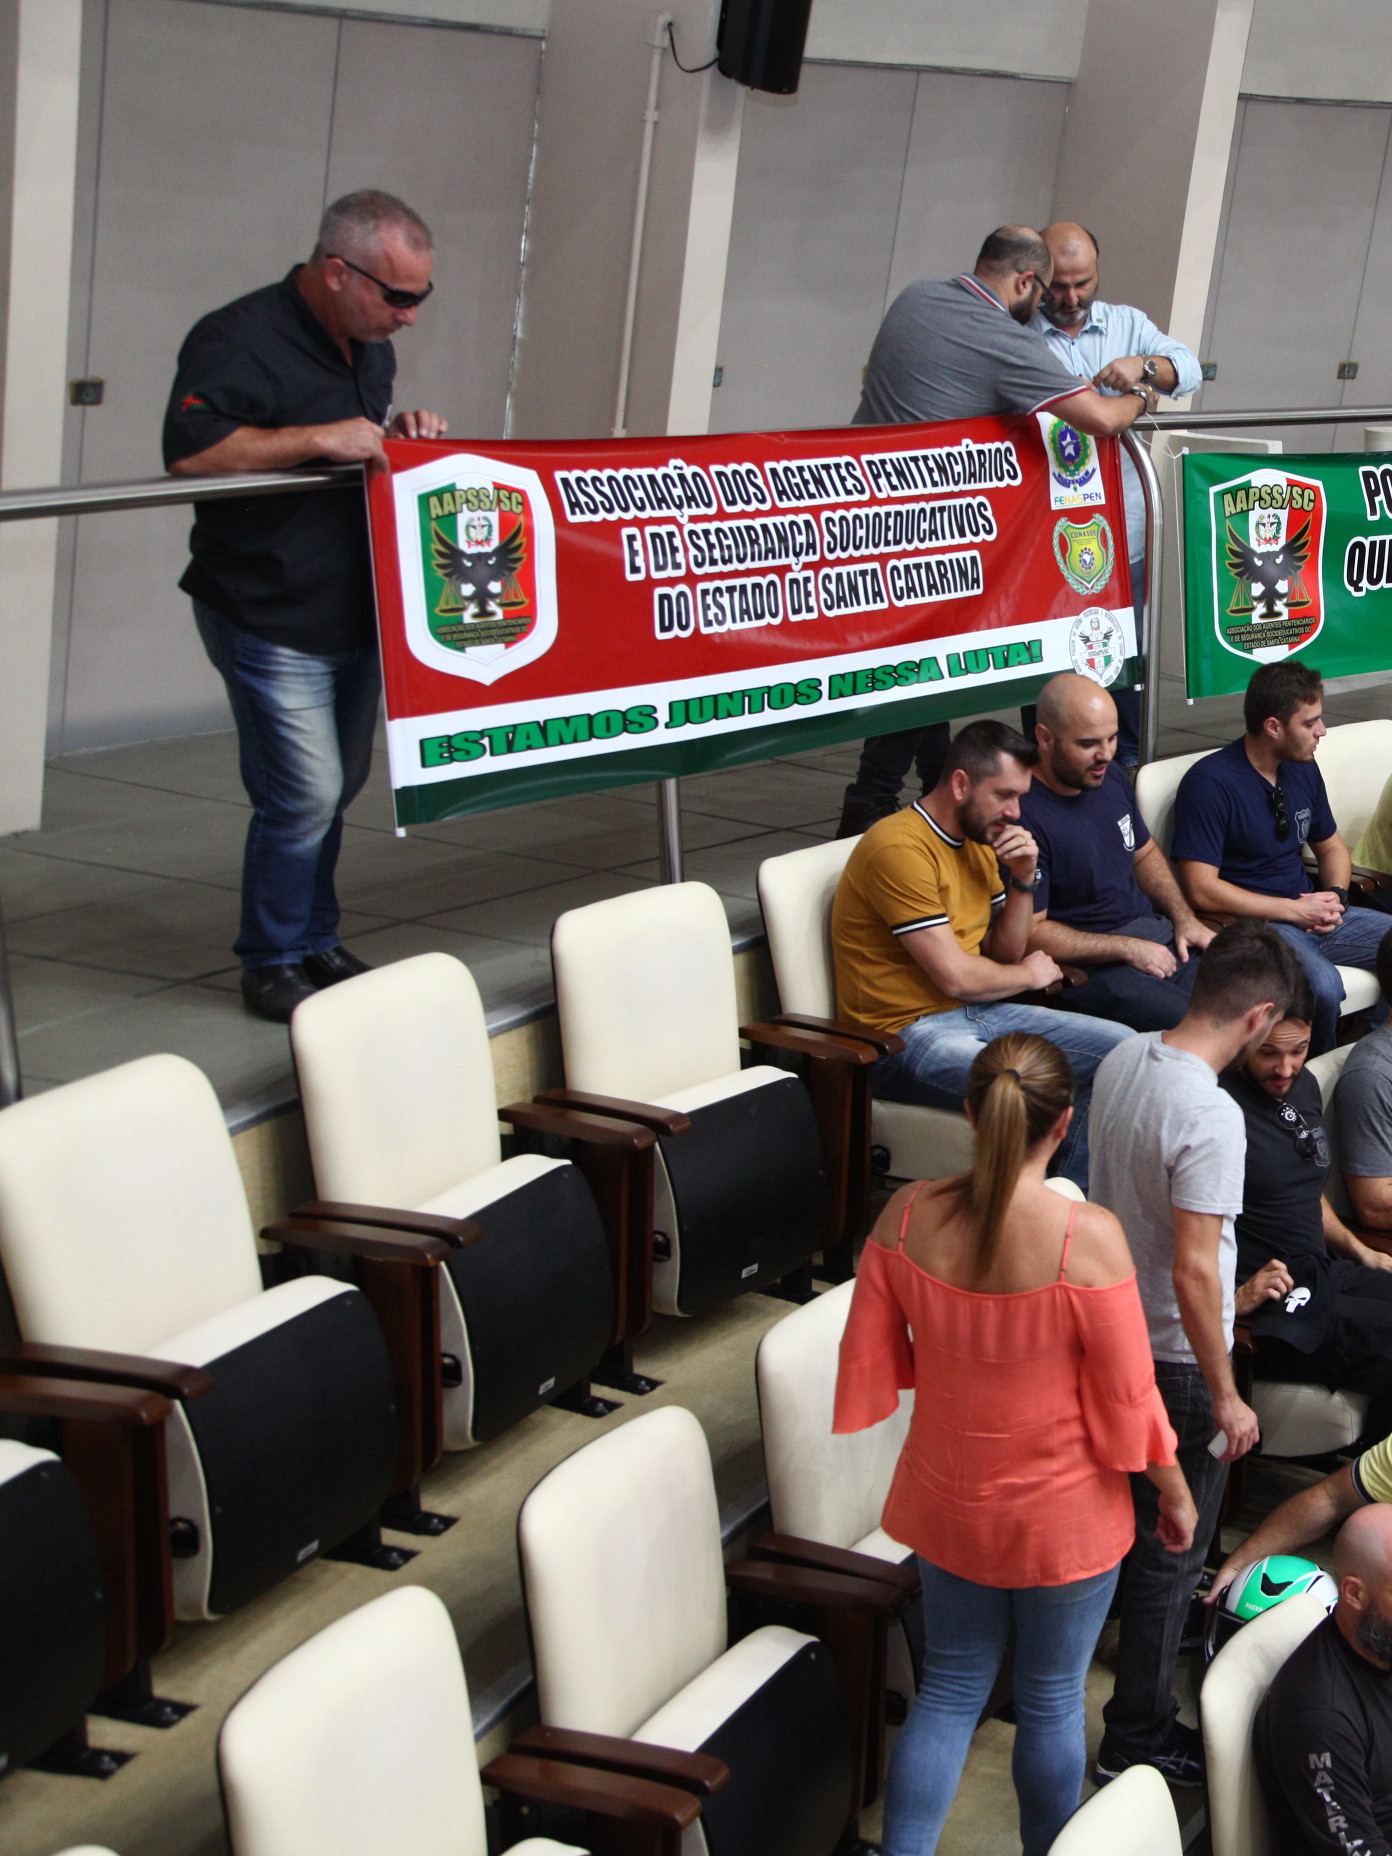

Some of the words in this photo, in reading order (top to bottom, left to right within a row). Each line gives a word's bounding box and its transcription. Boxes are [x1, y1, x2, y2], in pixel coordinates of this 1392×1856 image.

[429, 486, 524, 520] AAPSS/SC
[559, 462, 714, 521] ASSOCIAÇÃO
[715, 467, 765, 508] DOS
[769, 459, 866, 504] AGENTES
[866, 442, 1019, 494] PENITENCIÁRIOS
[1054, 492, 1102, 506] FENASPEN
[1223, 482, 1316, 516] AAPSS/SC
[626, 531, 643, 576] E
[655, 529, 683, 573] DE
[692, 517, 818, 570] SEGURANÇA
[825, 500, 995, 552] SOCIOEDUCATIVOS
[1070, 529, 1097, 539] CONASSE
[658, 590, 690, 635] DO
[702, 578, 779, 630] ESTADO
[788, 574, 815, 616] DE
[821, 567, 884, 613] SANTA
[889, 555, 981, 603] CATARINA
[420, 704, 658, 769] ESTAMOS
[665, 678, 823, 729] JUNTOS
[828, 656, 942, 700] NESSA
[947, 639, 1044, 680] LUTA!
